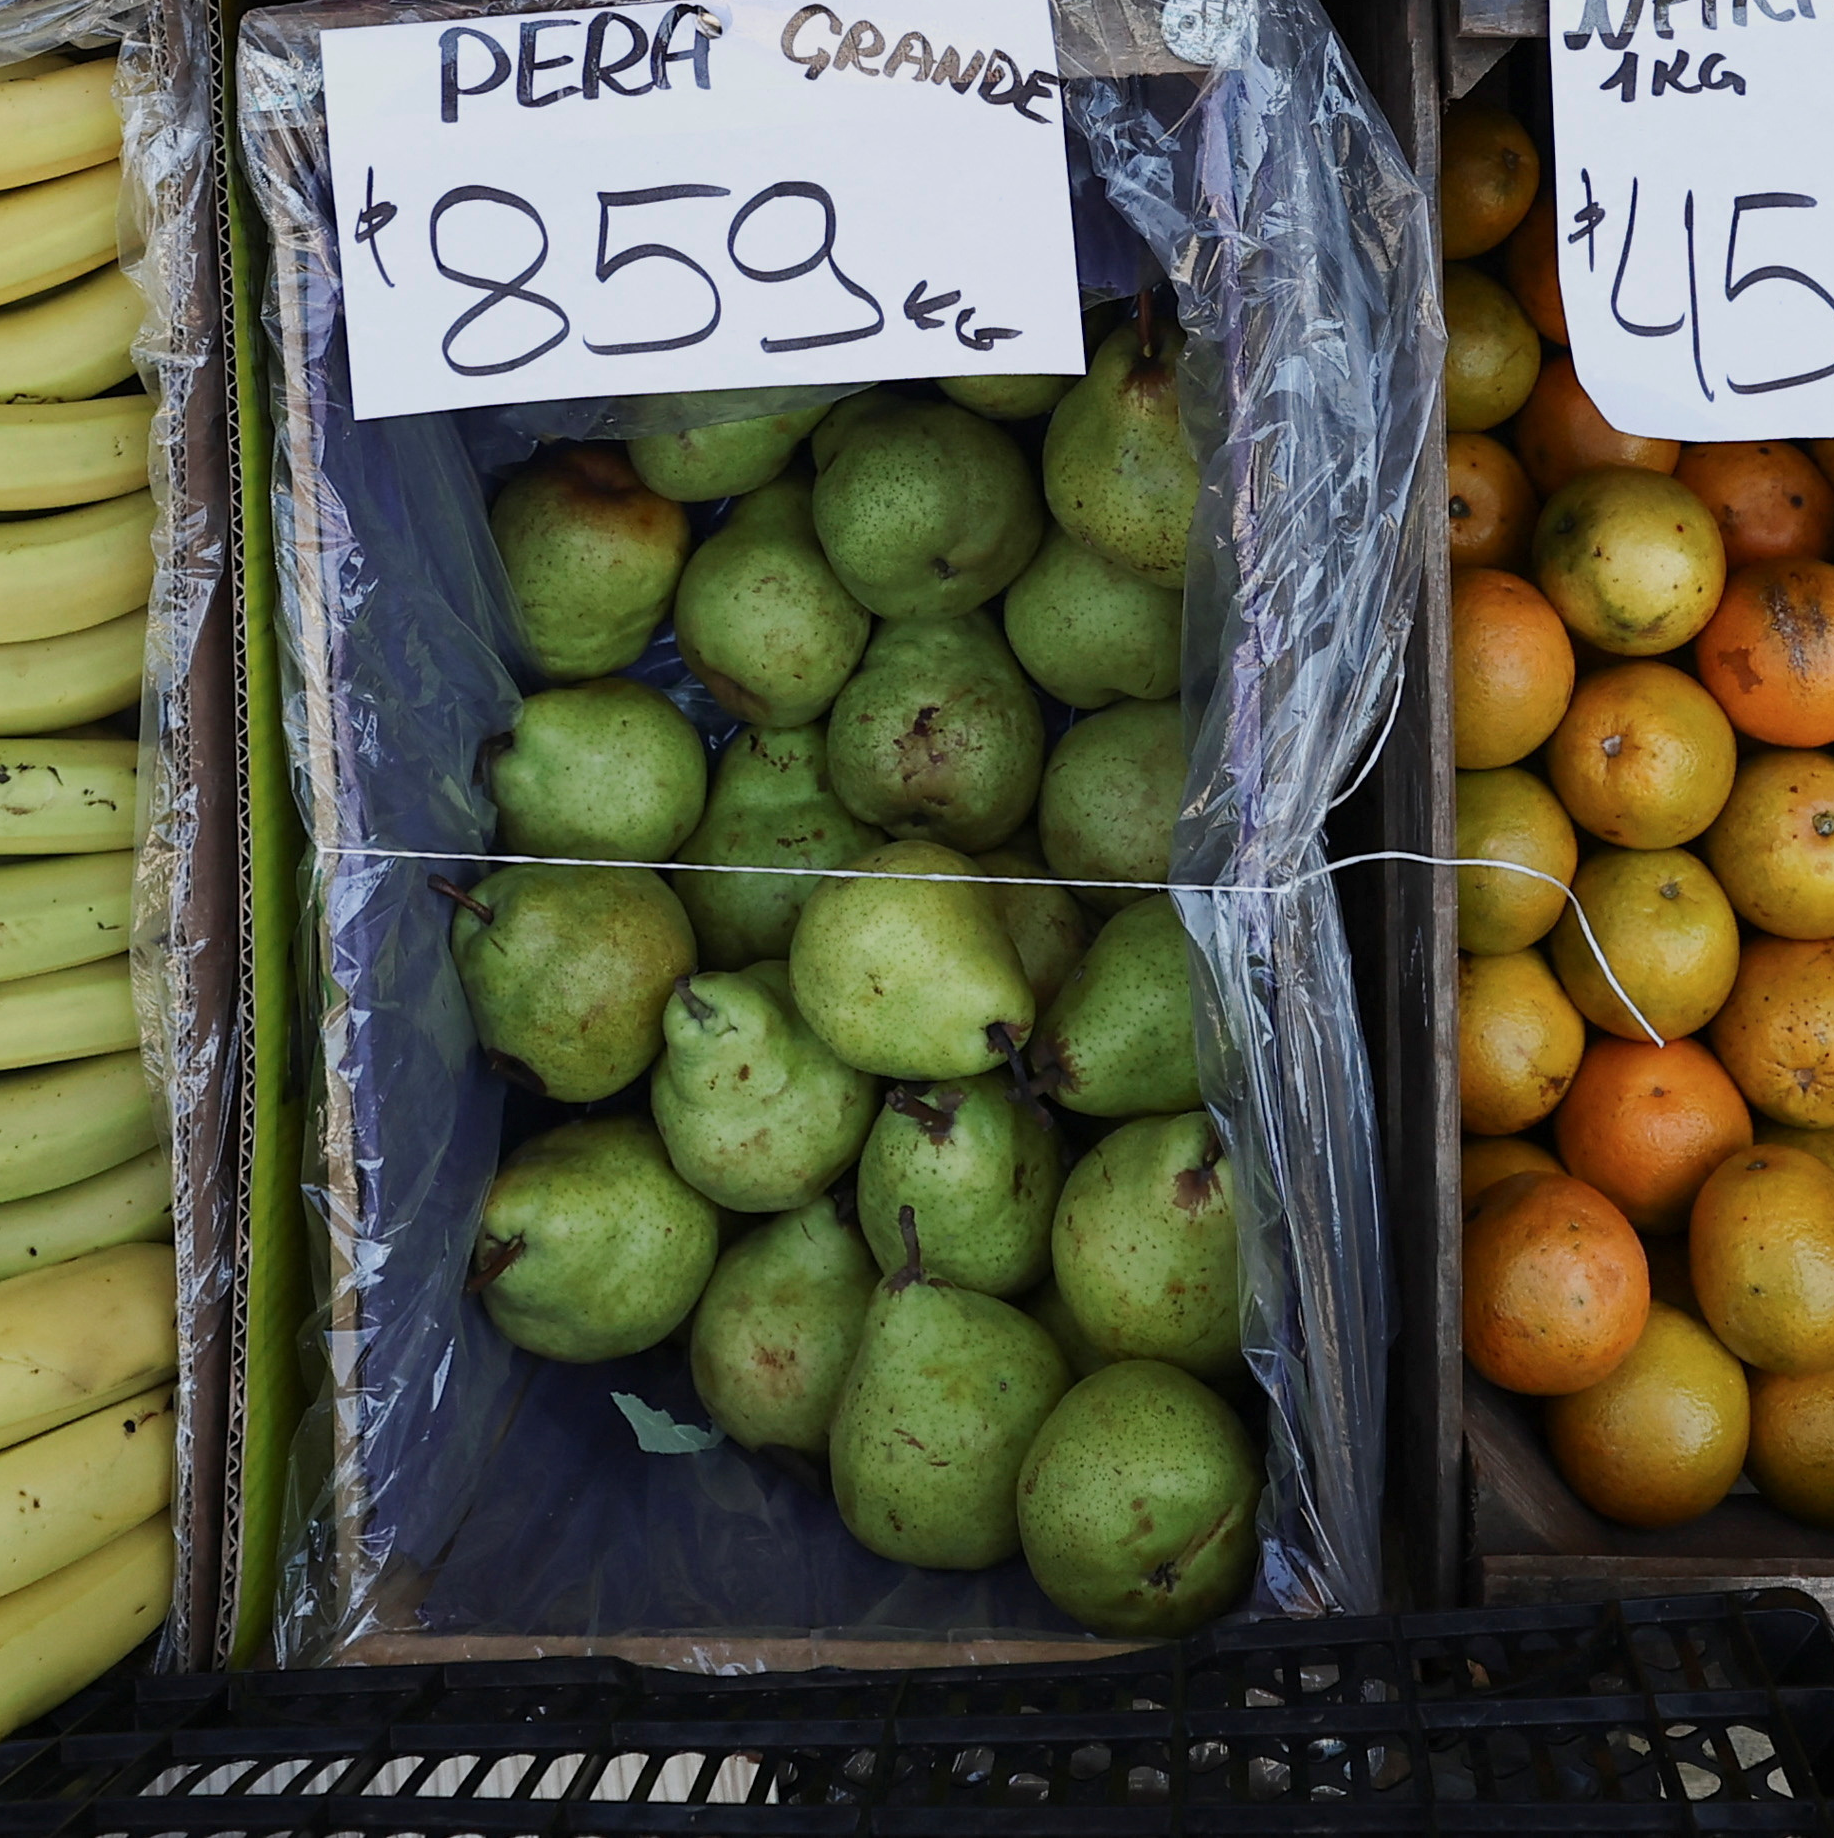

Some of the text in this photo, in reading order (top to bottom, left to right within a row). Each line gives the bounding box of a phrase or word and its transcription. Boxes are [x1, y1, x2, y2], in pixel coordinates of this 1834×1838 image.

[441, 3, 1063, 125] PERA GRANDE
[1599, 51, 1747, 102] 1KG
